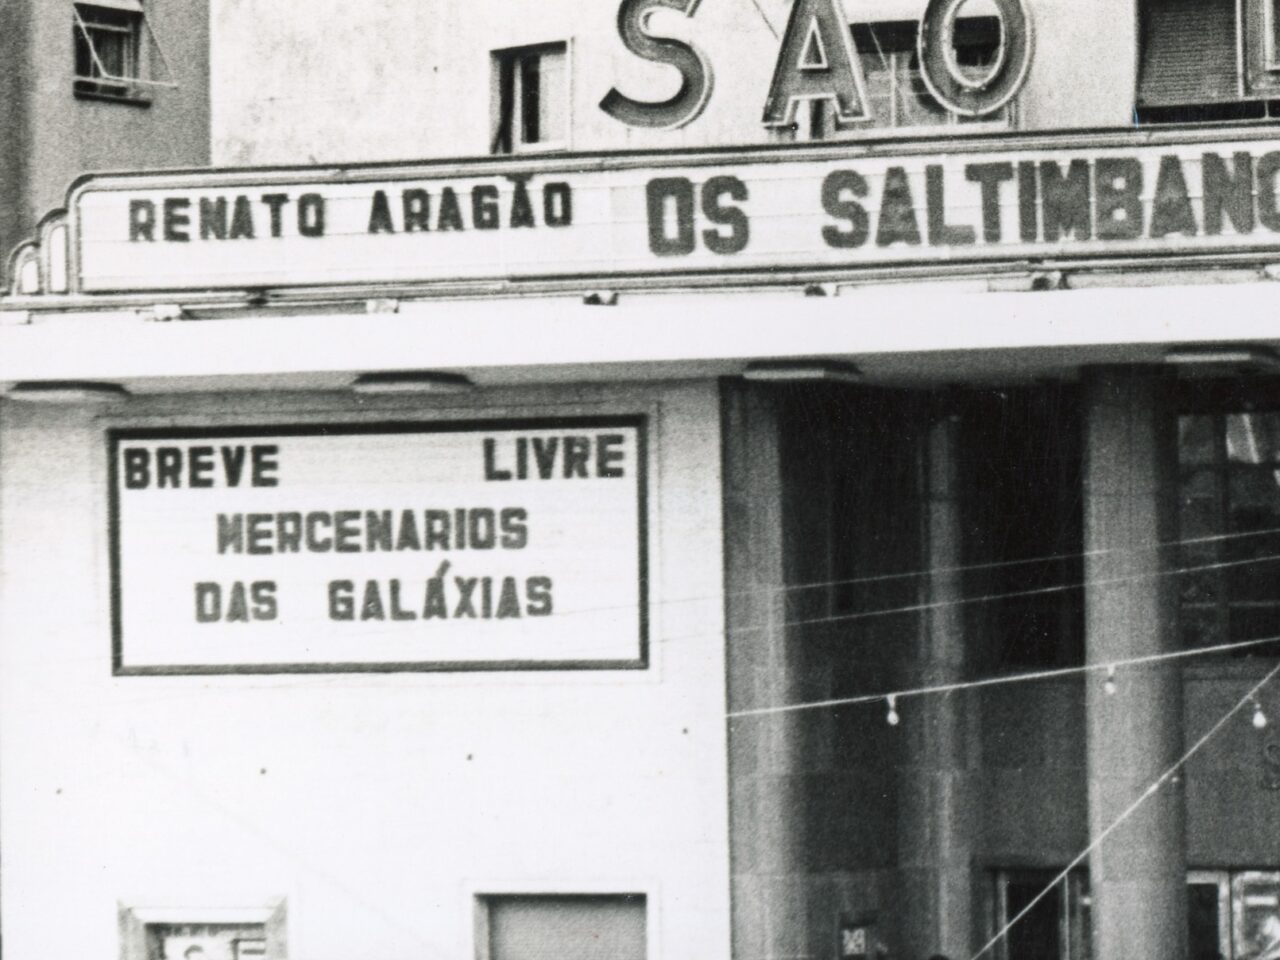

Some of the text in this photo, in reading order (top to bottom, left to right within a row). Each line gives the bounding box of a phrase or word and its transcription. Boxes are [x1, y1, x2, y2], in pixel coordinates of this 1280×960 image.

[129, 193, 326, 243] RENATO
[367, 176, 573, 235] ARAGÃO
[644, 175, 750, 257] OS
[123, 433, 626, 490] BREVE LIVRE
[217, 507, 528, 555] MERCENARIOS
[195, 560, 553, 624] DAS GALÁXIAS
